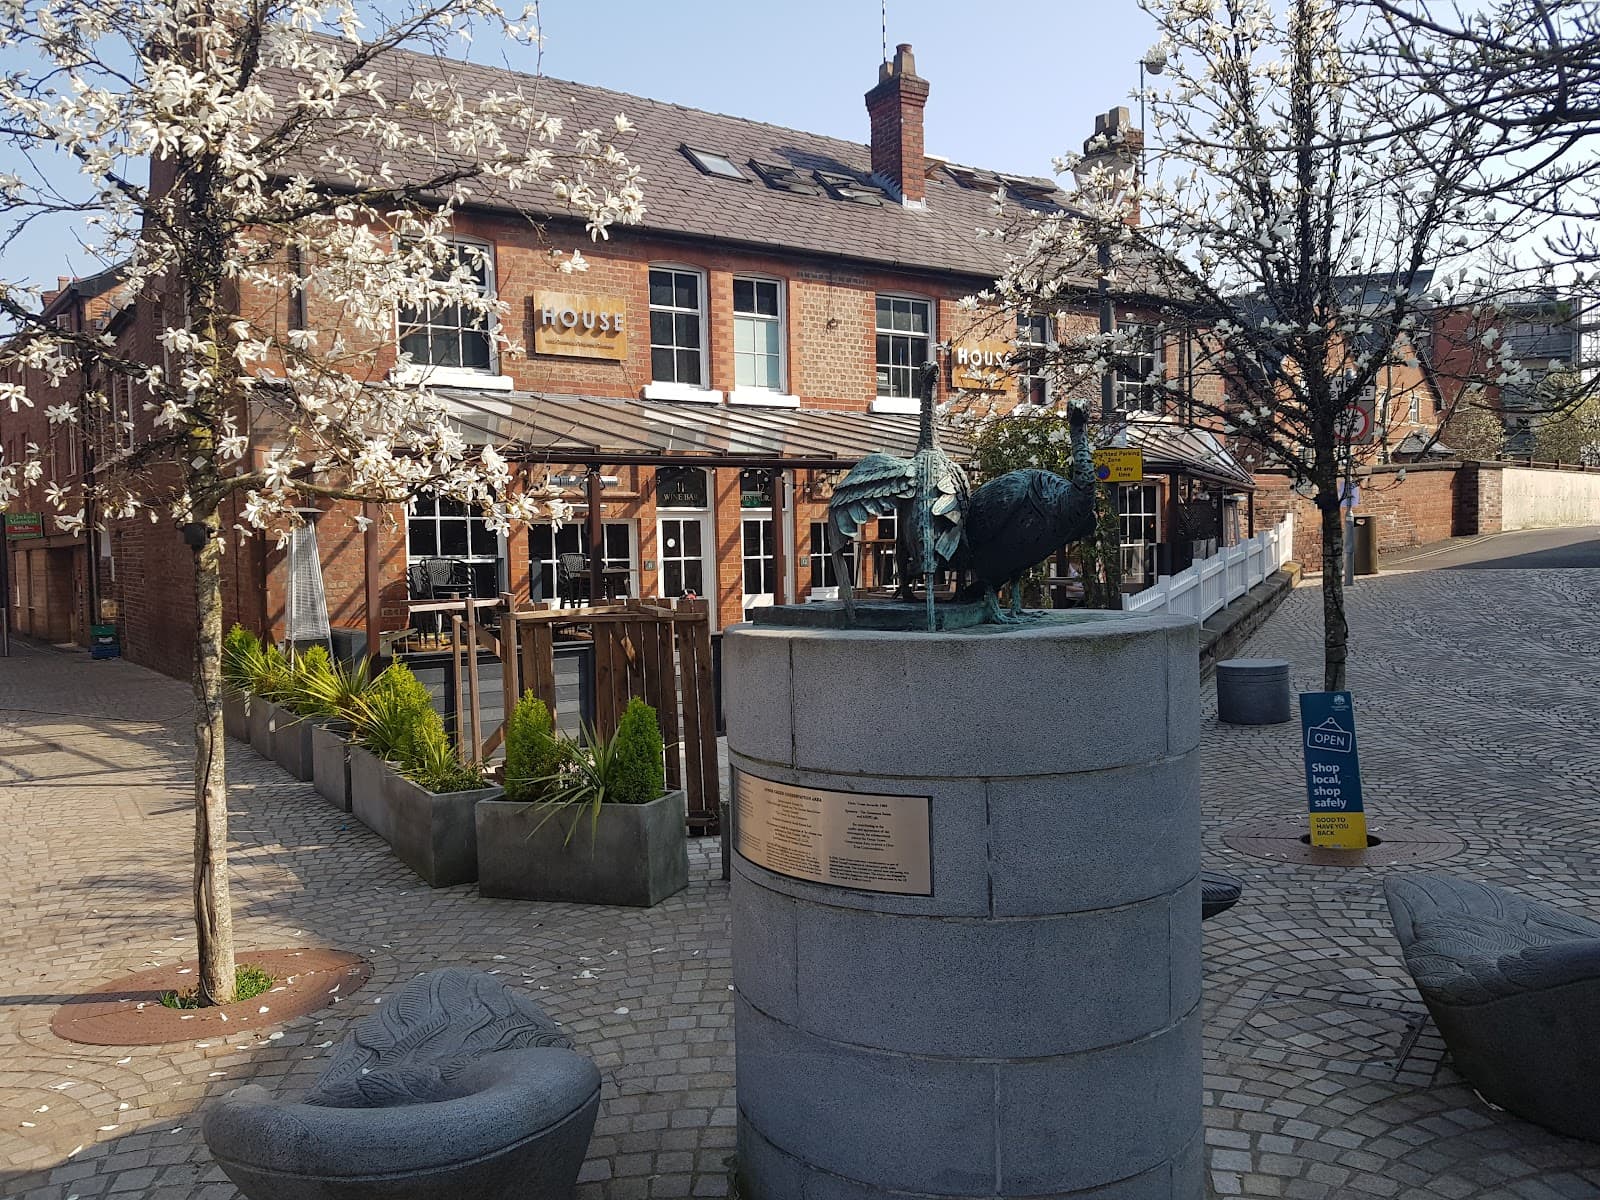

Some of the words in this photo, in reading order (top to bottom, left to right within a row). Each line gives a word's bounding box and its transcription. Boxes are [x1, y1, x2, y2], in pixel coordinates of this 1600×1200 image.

[541, 304, 624, 332] HOUSE
[663, 493, 683, 501] WINE
[1314, 733, 1345, 747] OPEN
[1311, 762, 1340, 774] Shop
[1312, 774, 1342, 785] local,
[1313, 786, 1341, 797] shop
[1314, 797, 1347, 809] safely
